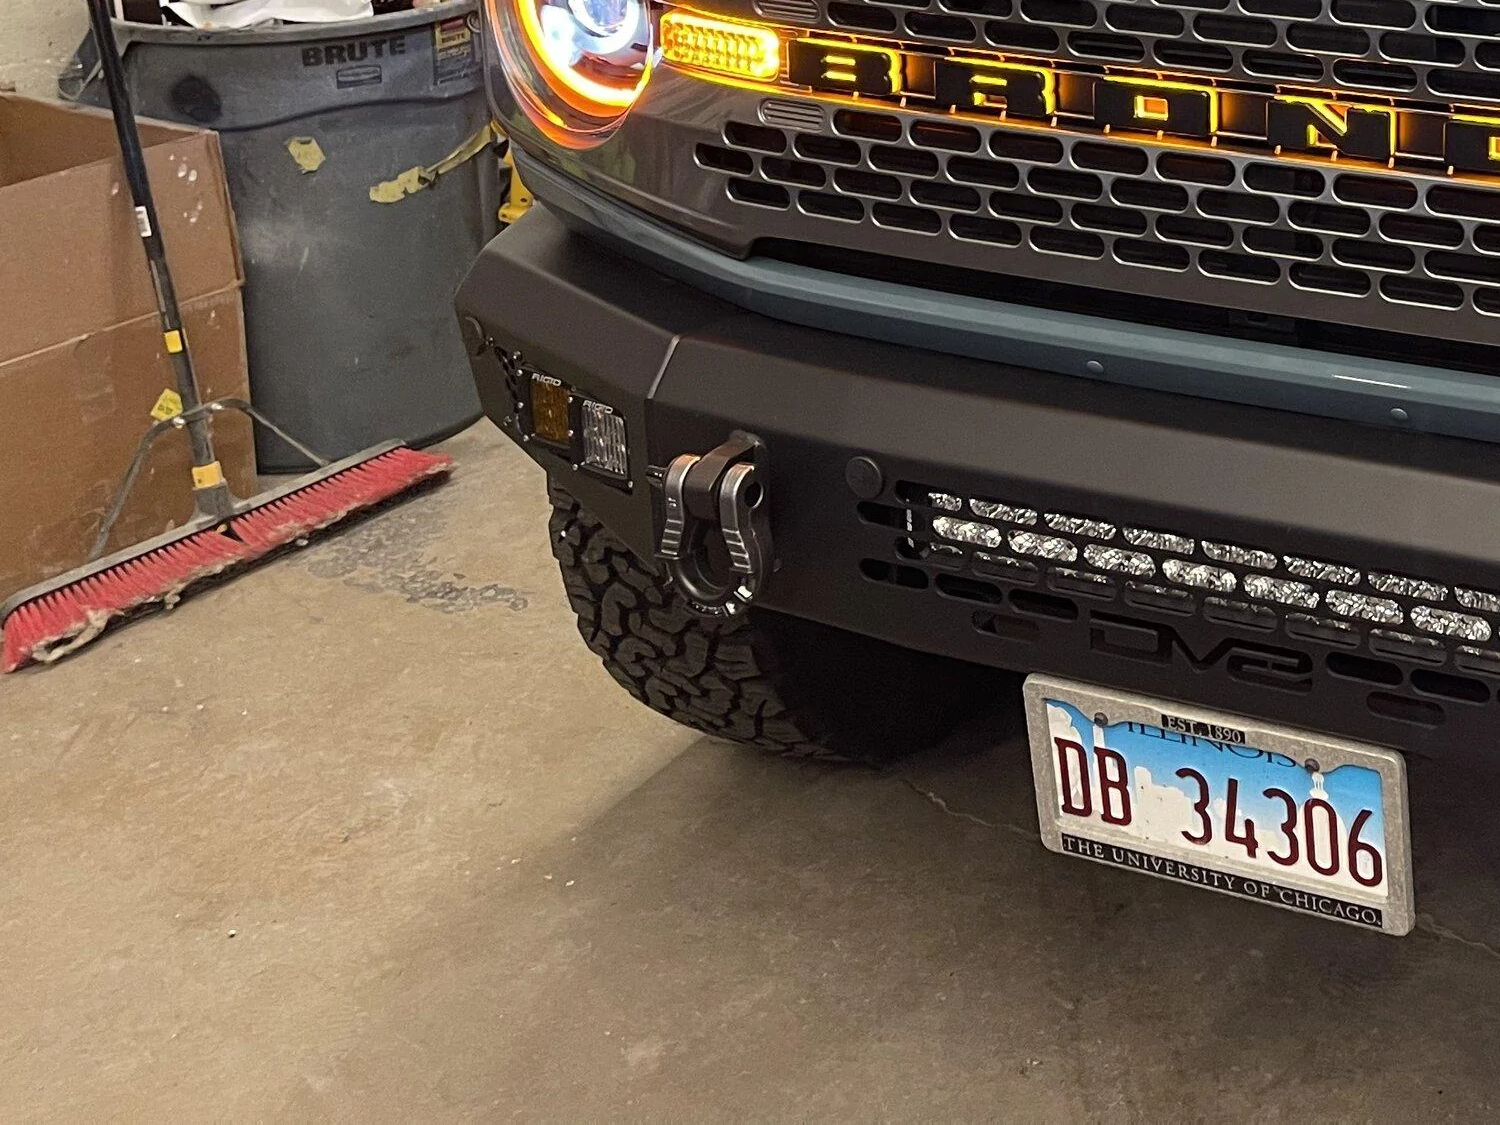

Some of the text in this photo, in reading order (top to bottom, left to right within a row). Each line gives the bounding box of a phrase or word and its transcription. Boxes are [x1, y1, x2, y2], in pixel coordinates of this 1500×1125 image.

[302, 35, 406, 67] BRUTE
[1166, 716, 1242, 744] EST. 1890
[1054, 736, 1384, 888] DB 34306
[1063, 835, 1105, 859] THE
[1111, 847, 1236, 891] UNIVERSITY
[1243, 880, 1270, 898] OF
